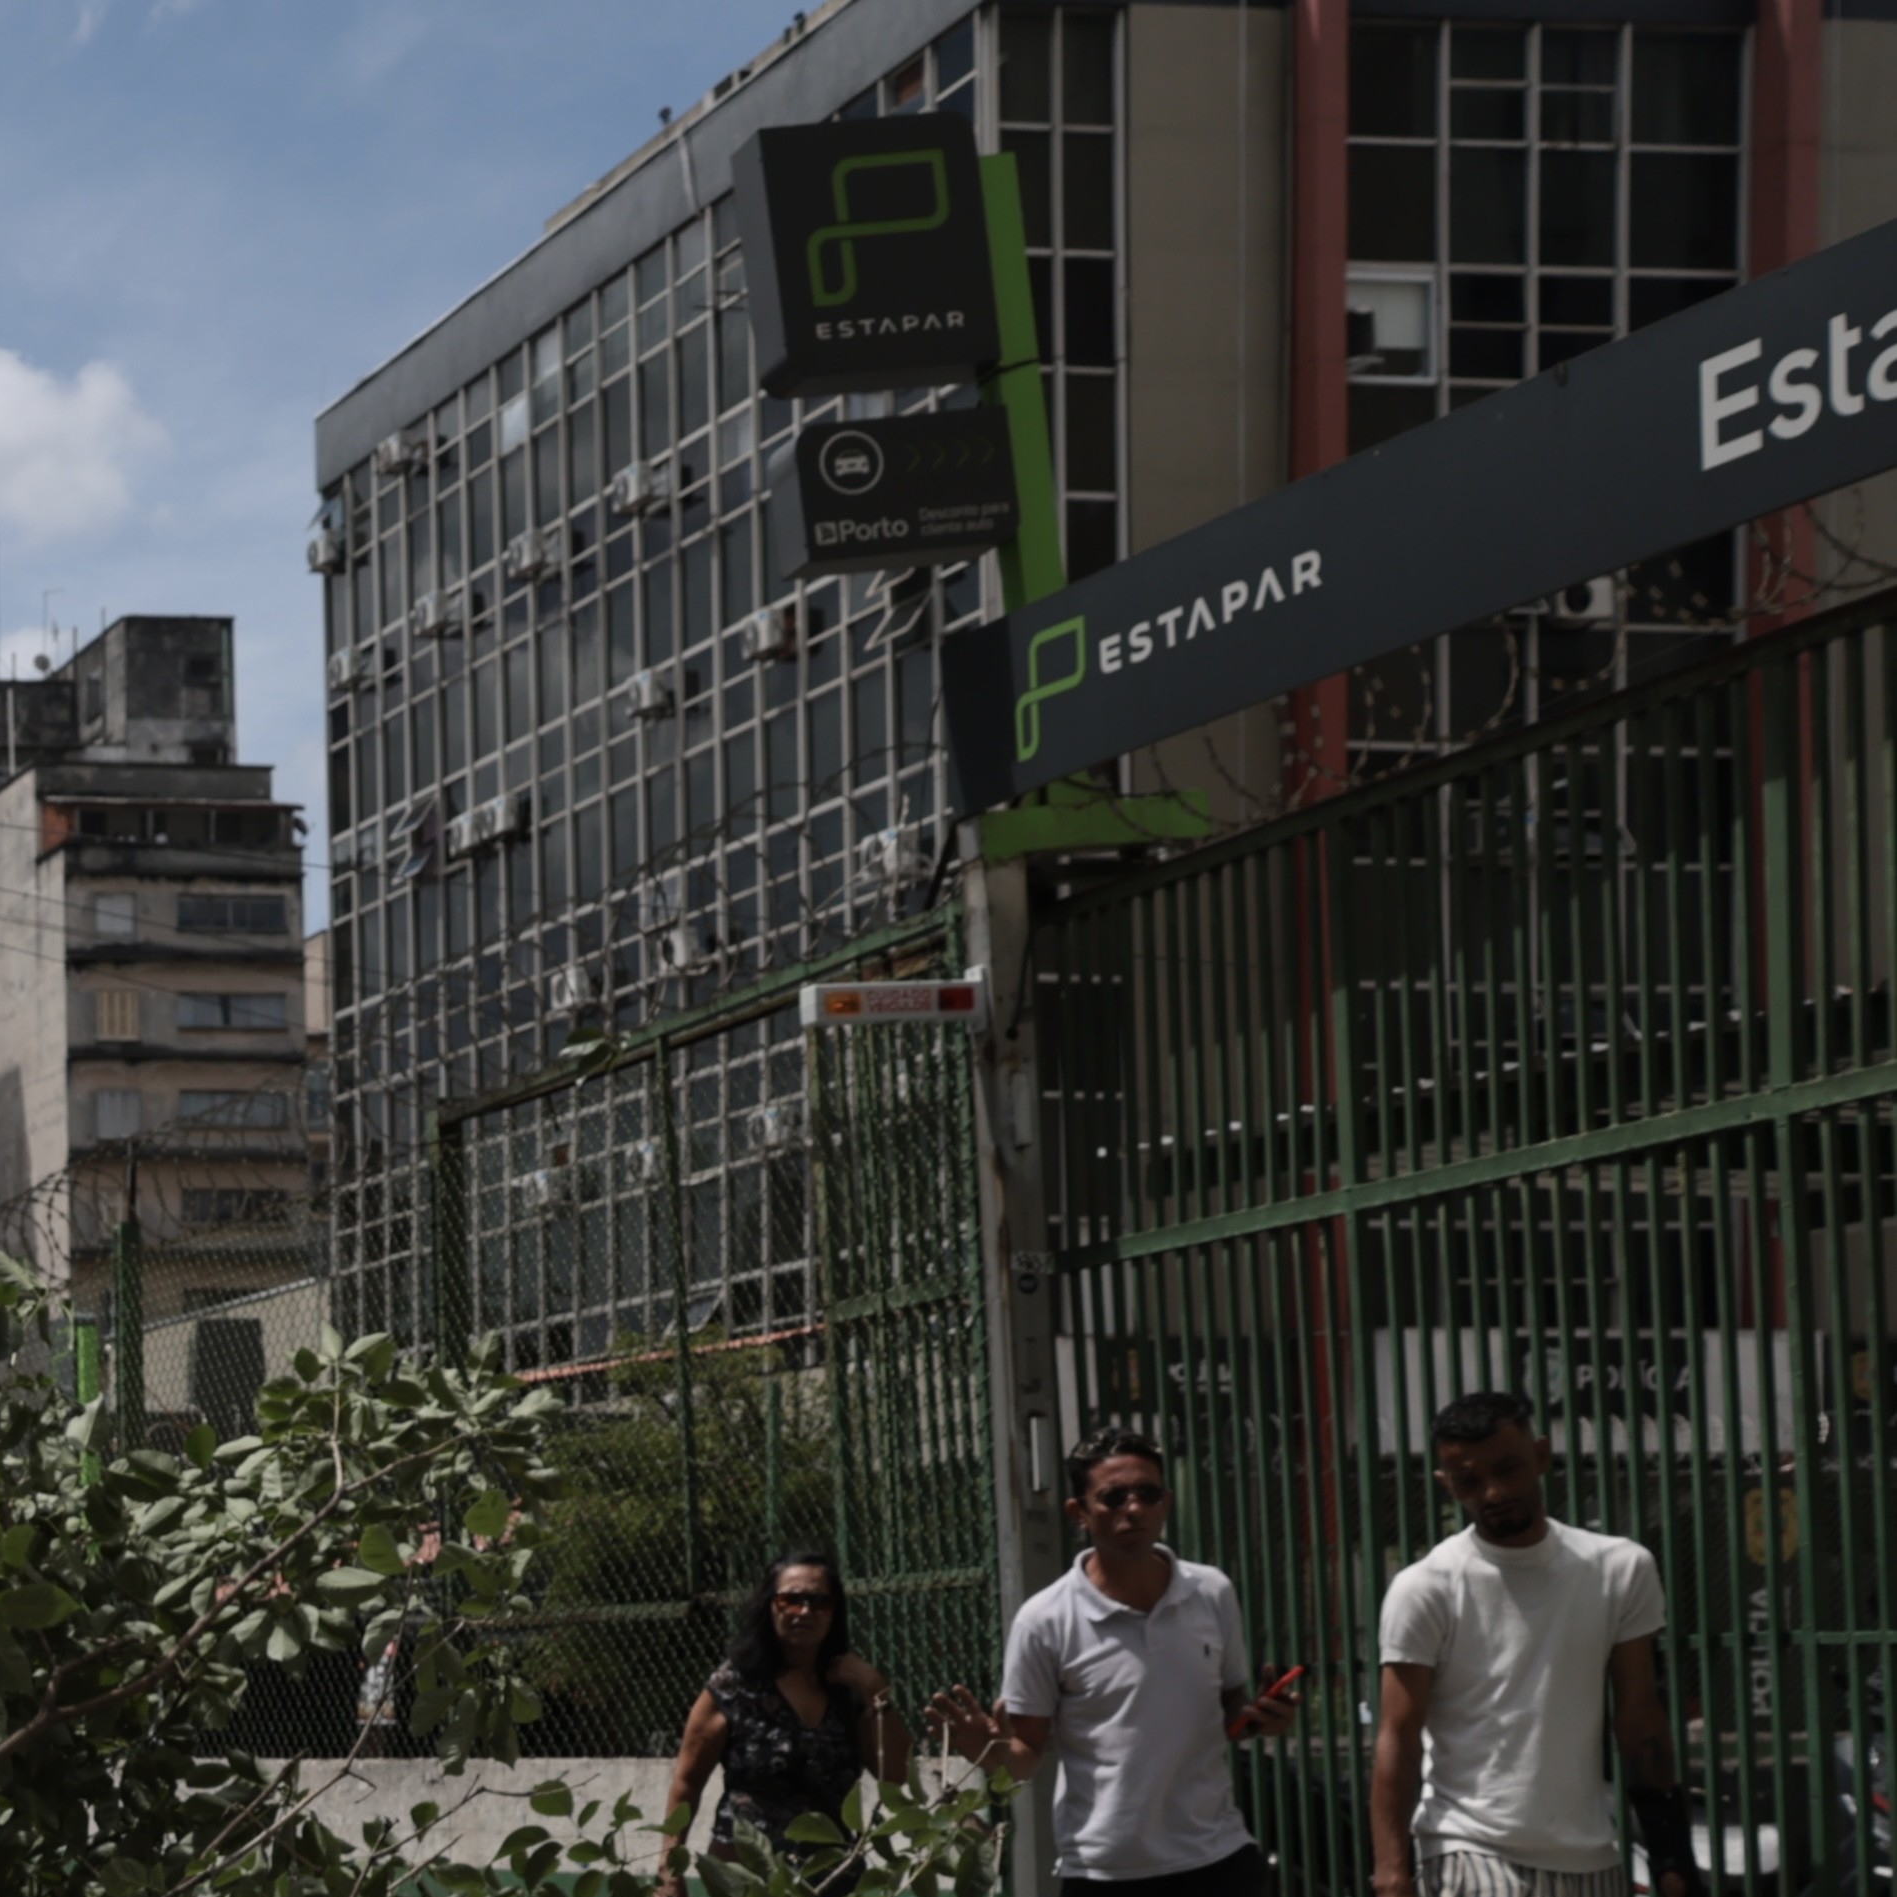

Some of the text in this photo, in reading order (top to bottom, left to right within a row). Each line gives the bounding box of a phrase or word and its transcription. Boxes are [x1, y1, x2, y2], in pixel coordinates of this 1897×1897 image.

[815, 310, 965, 341] ESTAPAR
[839, 516, 909, 543] Porto
[1098, 548, 1323, 675] ESTAPAR
